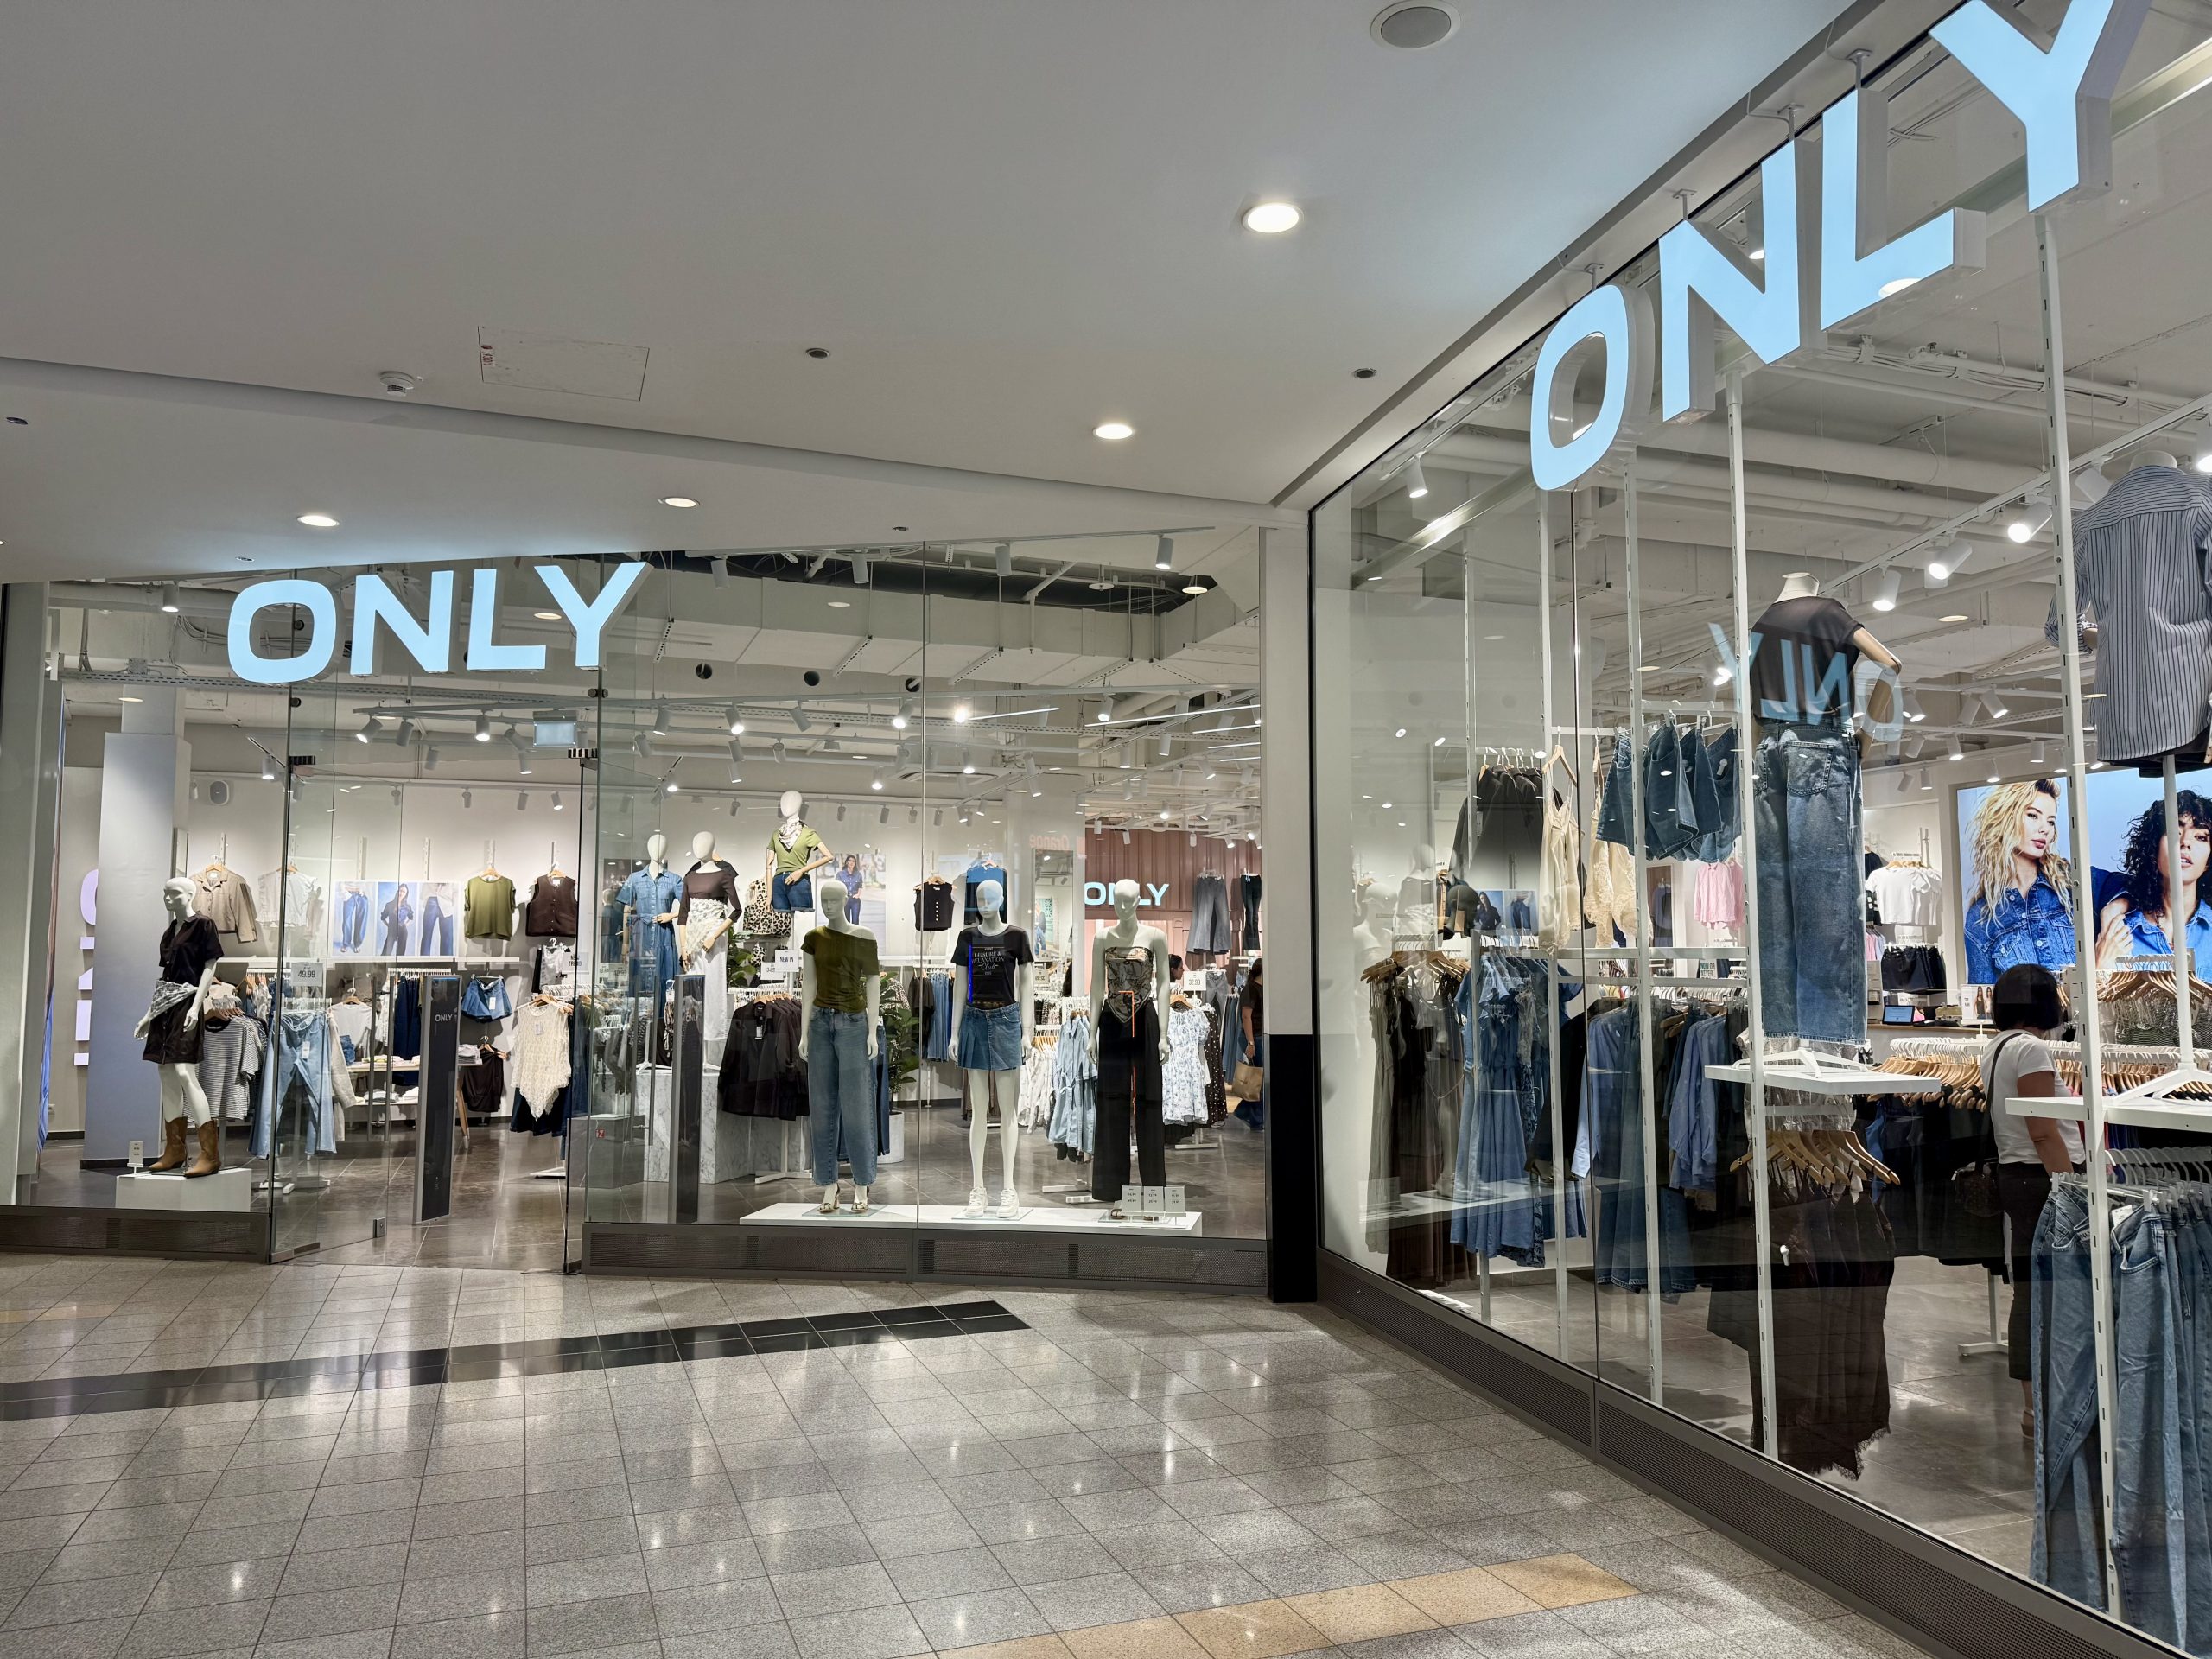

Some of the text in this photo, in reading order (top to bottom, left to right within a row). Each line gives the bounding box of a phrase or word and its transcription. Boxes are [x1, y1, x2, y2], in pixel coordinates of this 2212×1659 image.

[1529, 0, 2119, 492] ONLY
[227, 562, 650, 683] ONLY
[435, 1014, 453, 1022] ONLY
